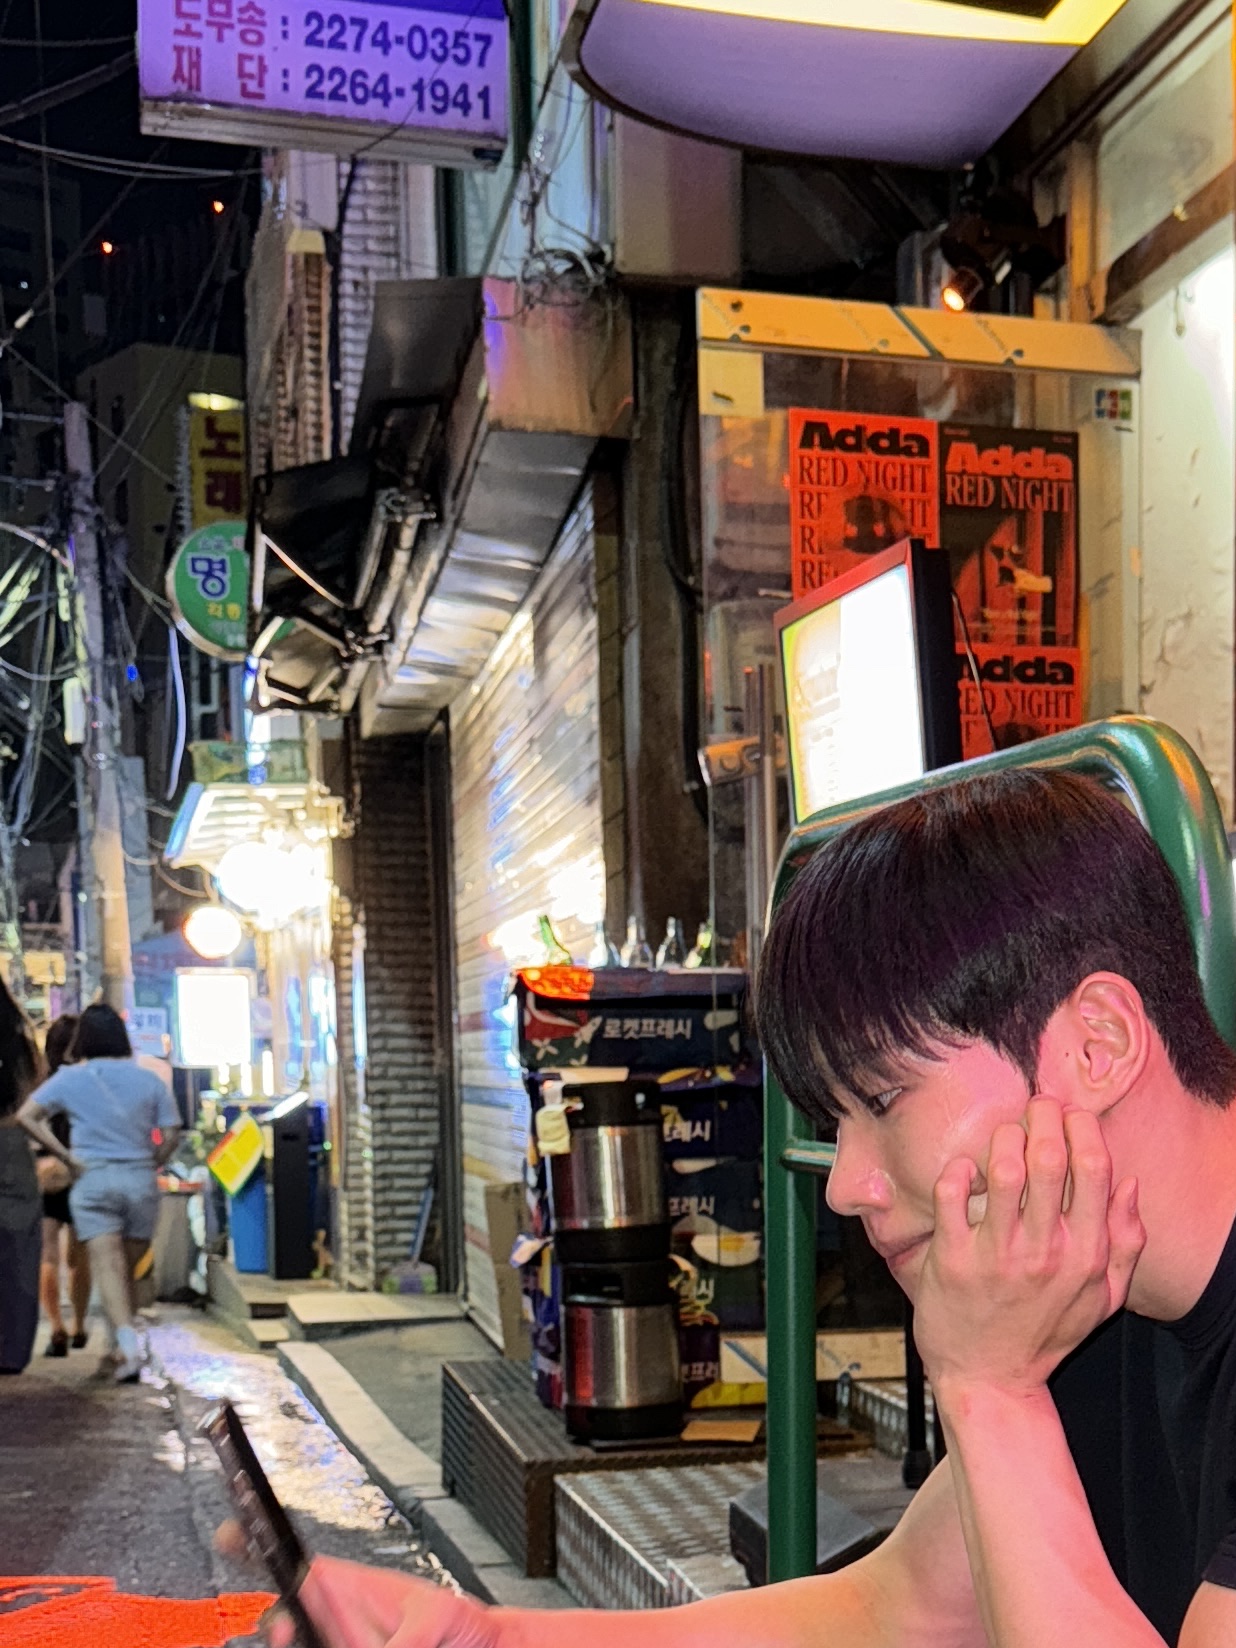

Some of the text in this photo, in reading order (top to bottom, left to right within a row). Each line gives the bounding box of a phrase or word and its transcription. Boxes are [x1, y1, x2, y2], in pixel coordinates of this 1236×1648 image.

[304, 11, 493, 68] 2274-0357
[304, 64, 492, 119] 2264-1941
[799, 420, 930, 459] Adda
[799, 456, 931, 493] RED NIGHT
[945, 441, 1074, 481] Adda
[945, 474, 1074, 512] RED NIGHT
[964, 688, 1075, 721] ED NIGHT
[603, 1018, 692, 1040] 로켓프레시
